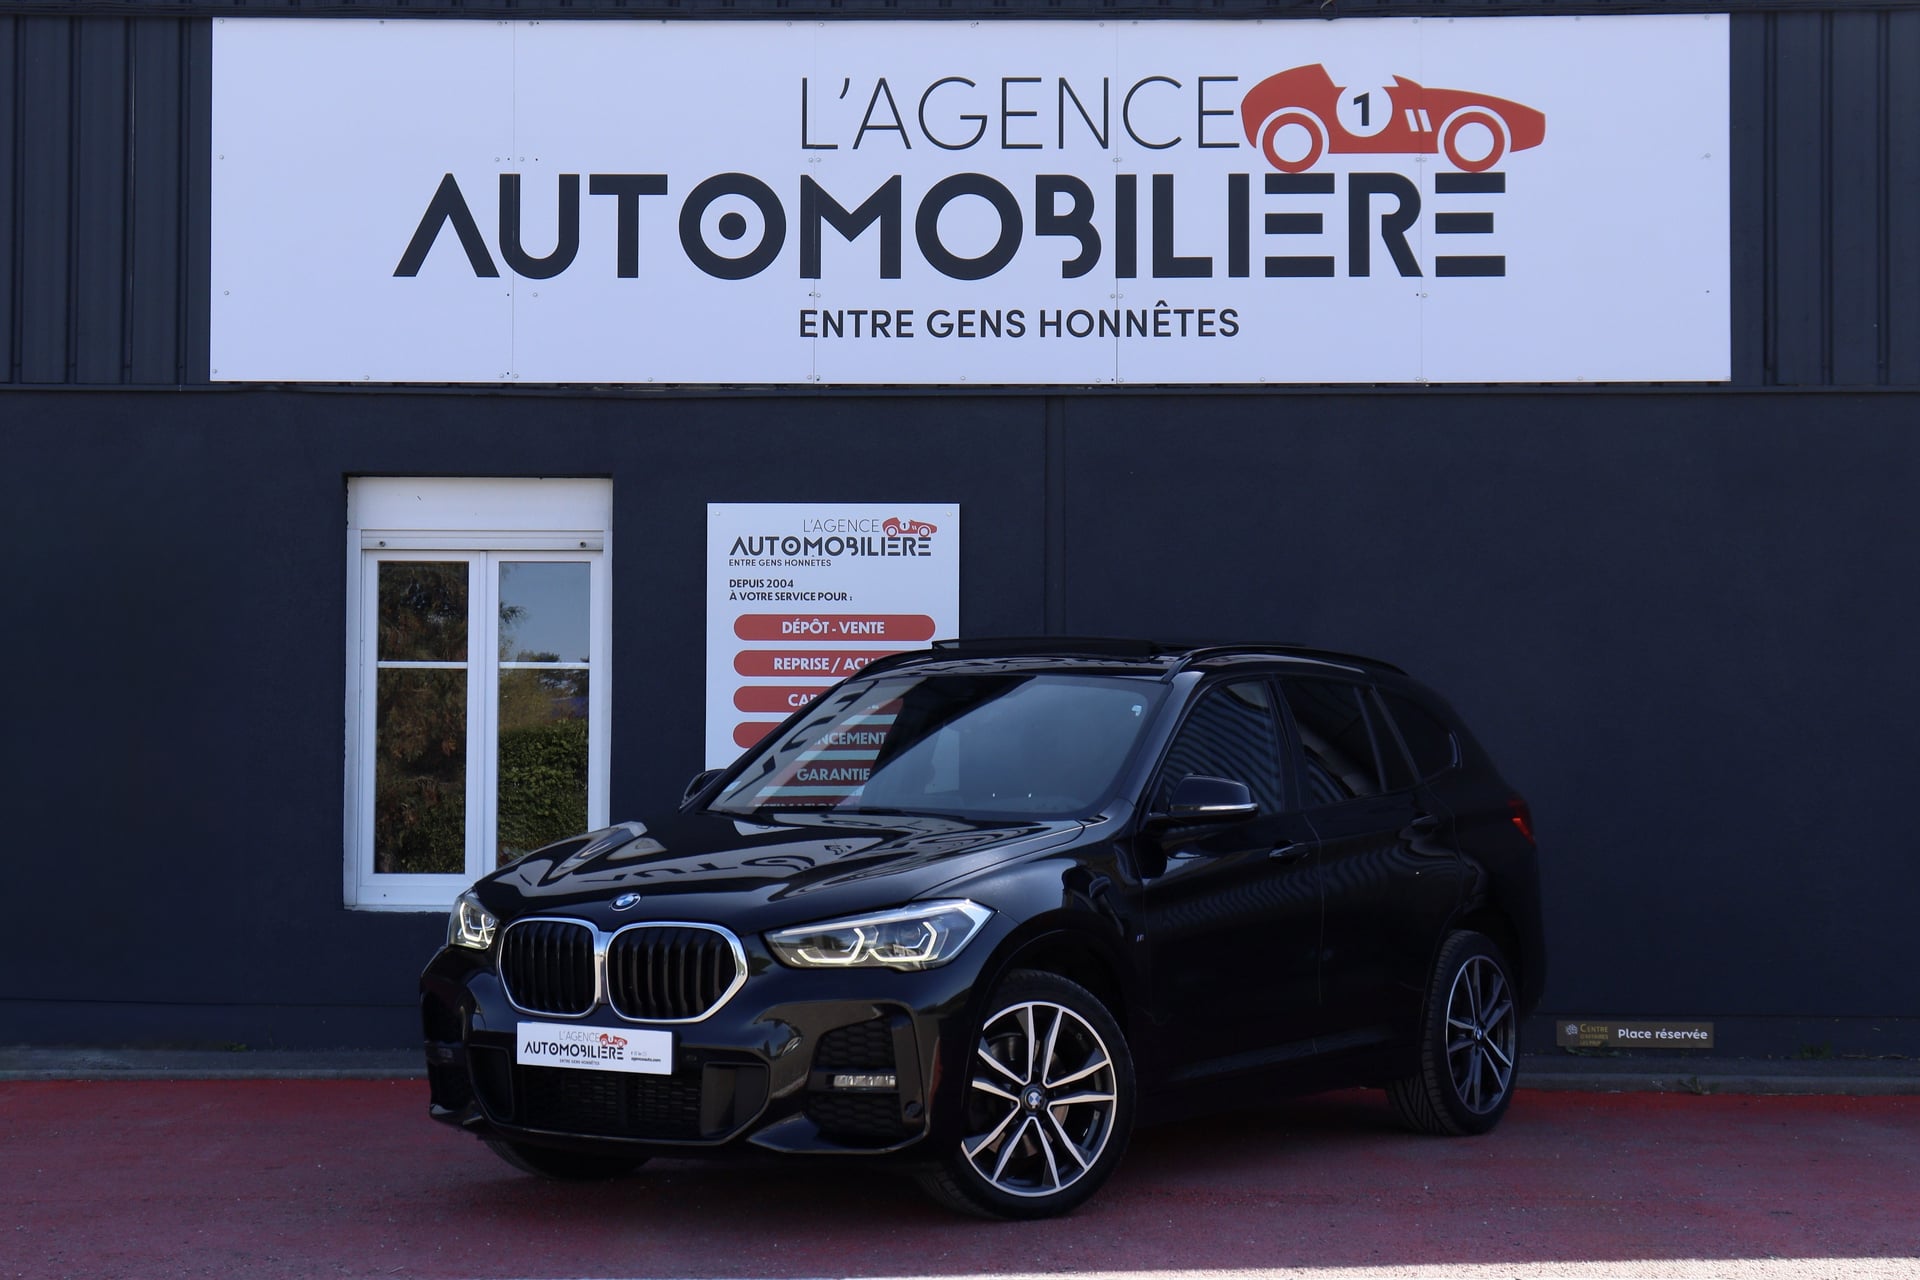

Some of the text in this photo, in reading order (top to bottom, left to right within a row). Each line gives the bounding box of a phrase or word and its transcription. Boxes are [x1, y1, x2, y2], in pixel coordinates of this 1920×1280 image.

[801, 76, 1241, 150] L'AGENCE
[1353, 93, 1370, 127] 1
[800, 300, 1240, 338] ENTRE GENS HONNÊTES
[803, 519, 880, 533] L'AGENCE
[729, 559, 756, 567] ENTRE
[758, 559, 782, 567] GENS
[729, 579, 794, 589] DEPUIS 2004
[729, 589, 738, 601] À
[739, 592, 773, 601] VOTRE
[775, 592, 816, 601] SERVICE
[818, 592, 848, 601] POUR
[782, 618, 829, 634] DÉPÔT
[839, 621, 885, 634] VENTE
[774, 657, 829, 671] REPRISE
[797, 767, 871, 781] GARANTIE
[1618, 1028, 1708, 1040] Place réservée
